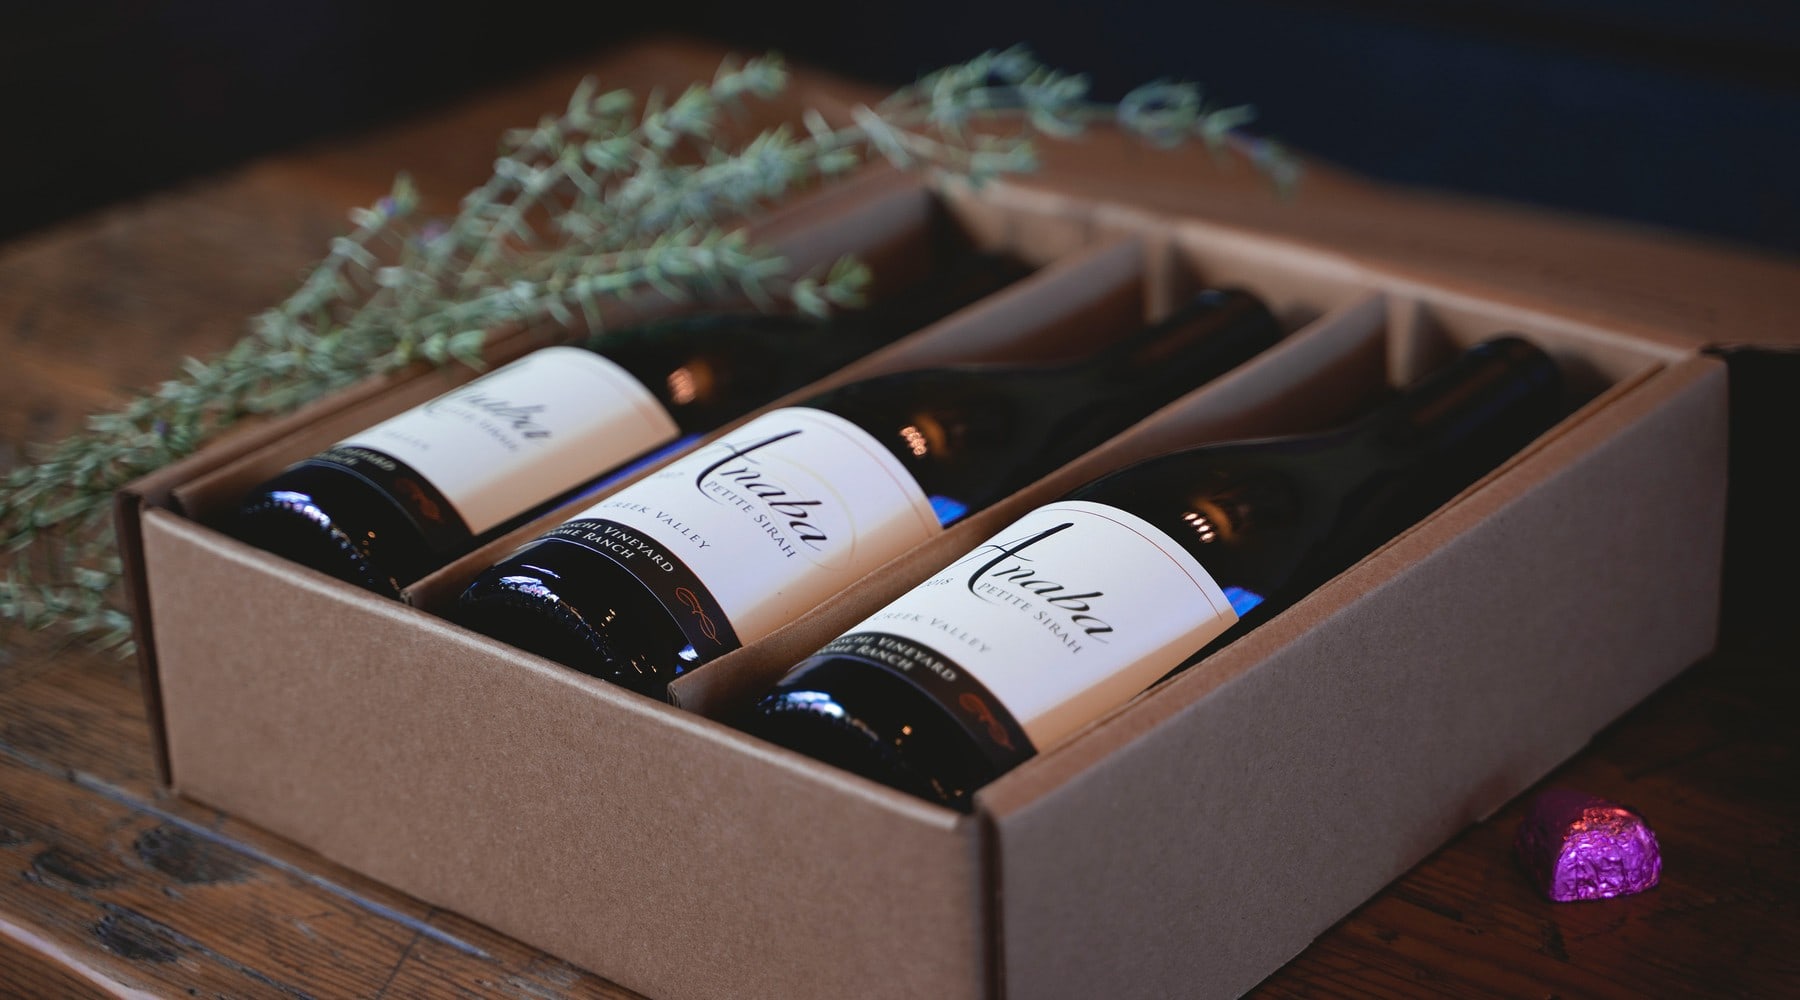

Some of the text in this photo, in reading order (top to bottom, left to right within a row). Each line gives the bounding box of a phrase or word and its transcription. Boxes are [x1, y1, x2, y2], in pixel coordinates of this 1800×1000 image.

[690, 429, 828, 552] Anaba
[655, 511, 711, 550] VALLEY
[703, 480, 797, 558] PETITE SIRAH
[583, 532, 636, 559] RANCH
[604, 526, 674, 573] VINEYARD
[952, 522, 1114, 644] Anaba
[929, 617, 991, 653] VALLEY
[977, 582, 1083, 654] PETITE SIRAH
[855, 645, 914, 671] RANCH
[878, 636, 957, 682] VINEYARD
